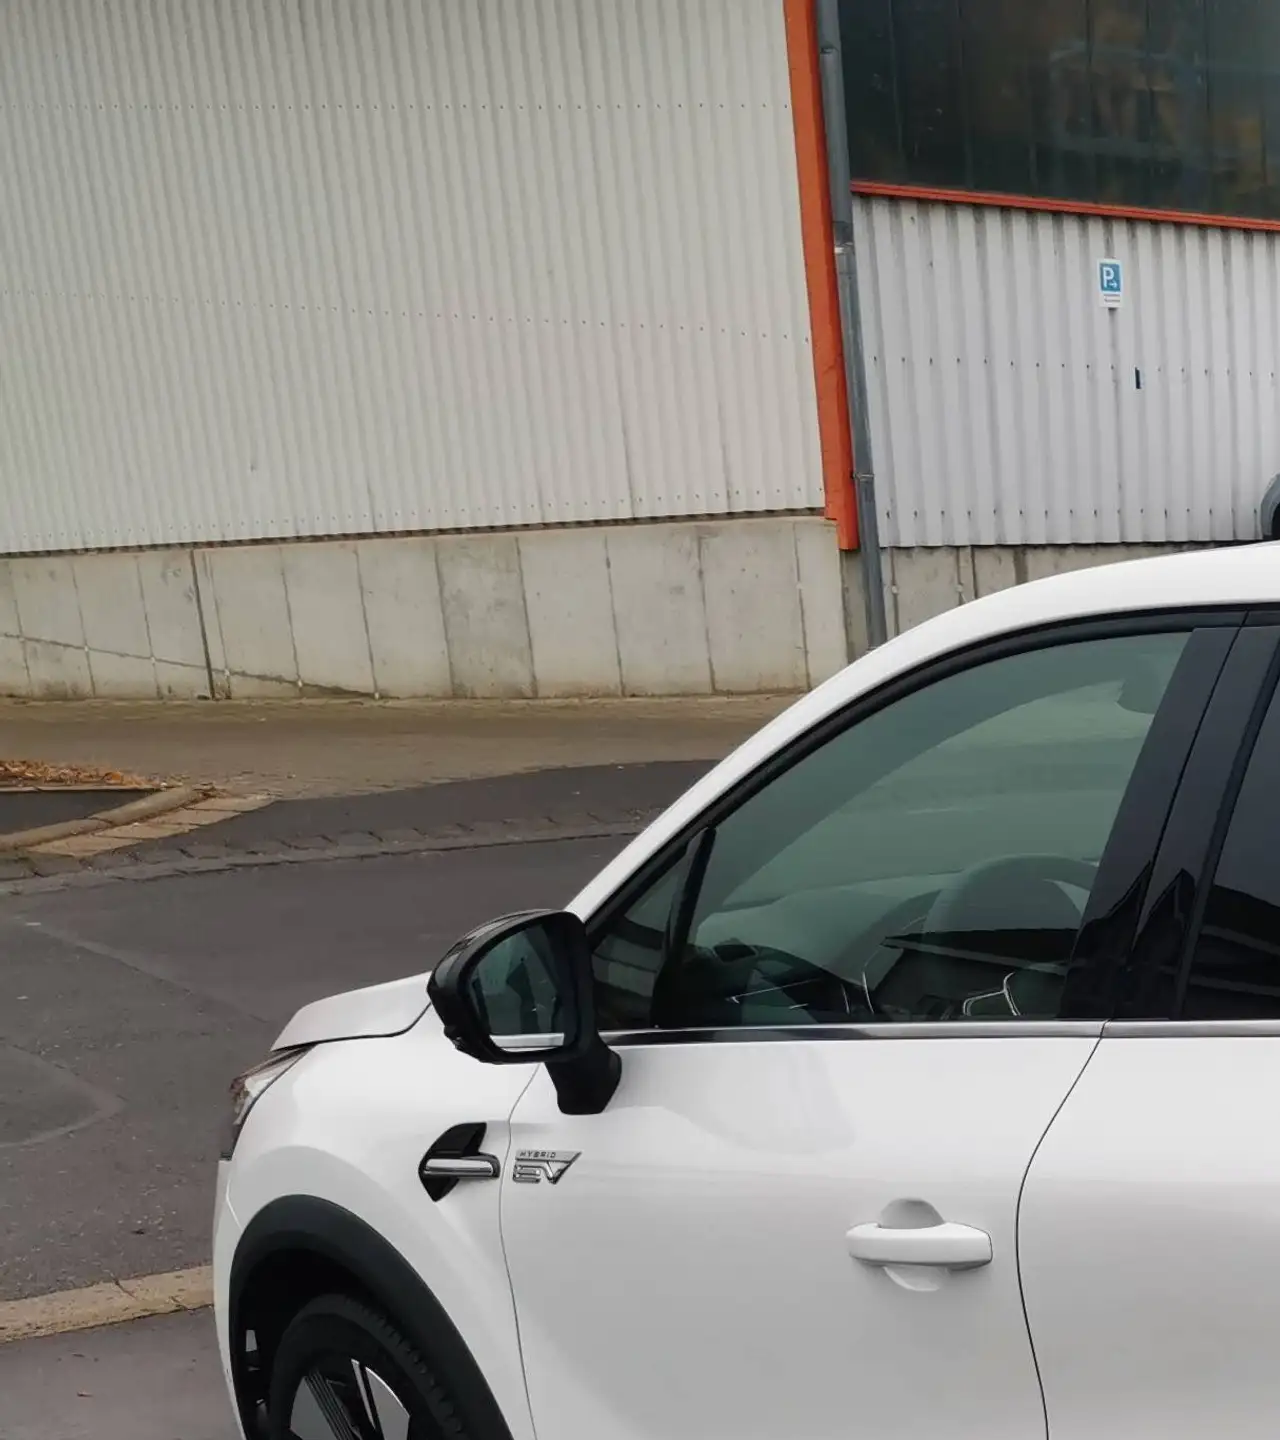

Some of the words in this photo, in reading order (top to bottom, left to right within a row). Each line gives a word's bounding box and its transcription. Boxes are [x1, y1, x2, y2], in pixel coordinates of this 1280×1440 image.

[1102, 266, 1115, 288] P
[519, 1151, 557, 1159] HYBRID
[512, 1153, 581, 1185] EV
